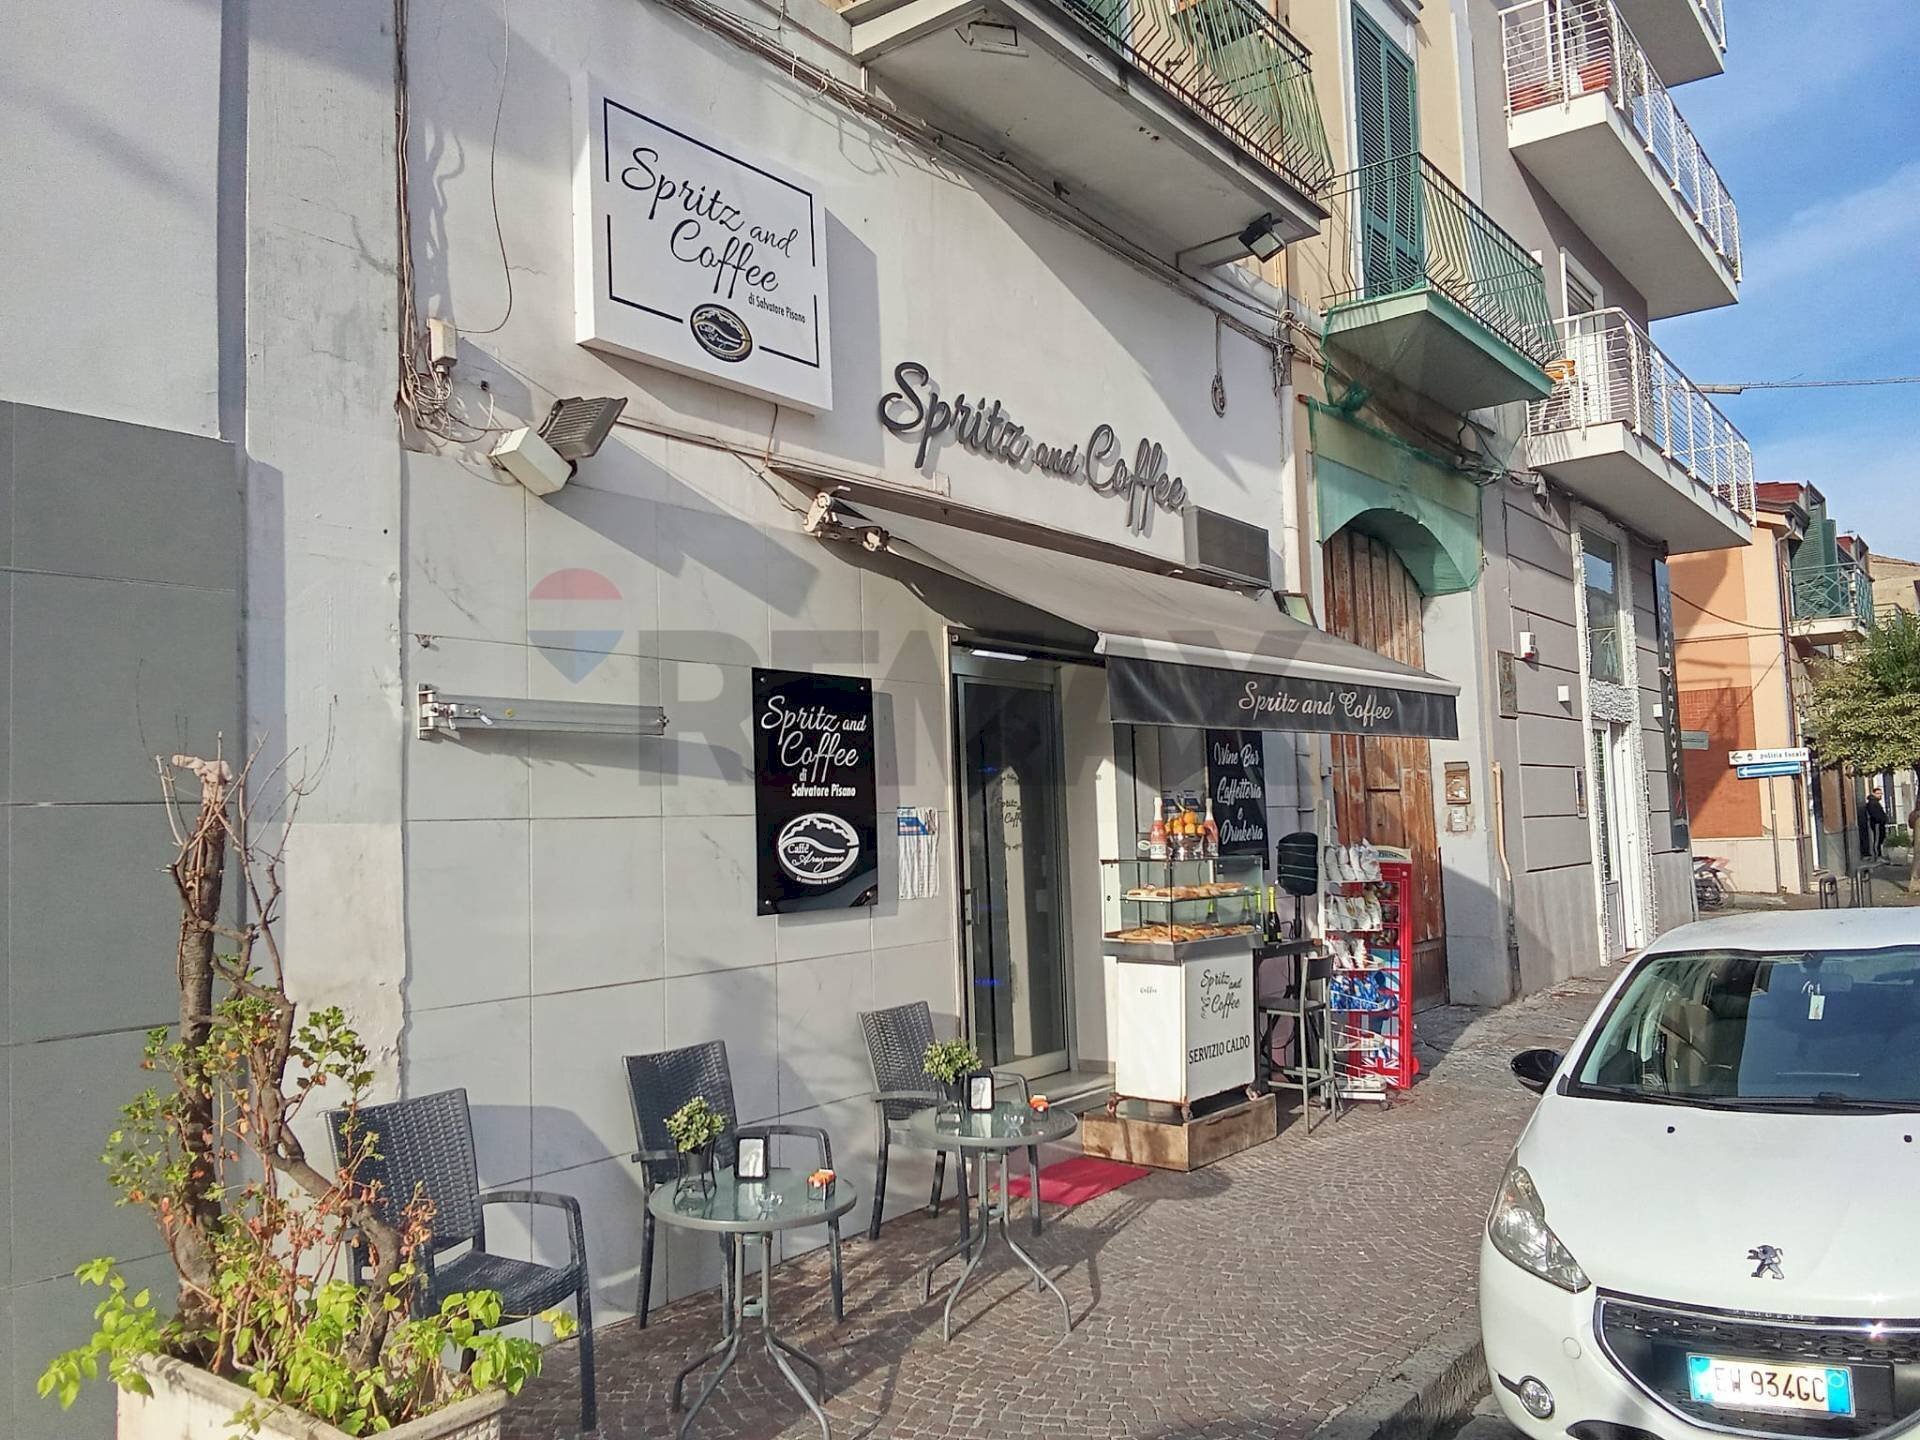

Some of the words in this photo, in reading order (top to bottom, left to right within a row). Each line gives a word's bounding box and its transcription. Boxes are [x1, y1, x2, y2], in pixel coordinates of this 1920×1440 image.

[621, 147, 745, 232] Spritz
[750, 226, 799, 259] and
[670, 219, 779, 299] Coffee
[748, 292, 755, 306] di
[756, 295, 785, 317] Salvatore
[785, 306, 806, 324] Pisano
[878, 361, 1029, 469] Spritz
[1032, 443, 1079, 477] and
[1086, 423, 1187, 531] Coffee
[1238, 681, 1301, 721] Spritz
[1301, 692, 1336, 716] and
[1338, 691, 1393, 727] Coffee
[761, 695, 840, 746] Spritz
[842, 714, 867, 731] and
[781, 731, 859, 783] Coffee
[1213, 742, 1239, 766] Wine
[1240, 743, 1260, 768] Bar
[792, 783, 829, 797] Salvatore
[831, 783, 856, 797] Pisano
[799, 768, 808, 782] di
[1217, 776, 1262, 806] Caffetteria
[1220, 819, 1264, 845] Drinkeria
[1200, 968, 1230, 995] Spritz
[1211, 992, 1240, 1019] Coffee
[1188, 1041, 1225, 1065] SERVIZIO
[1225, 1034, 1251, 1055] CALDO
